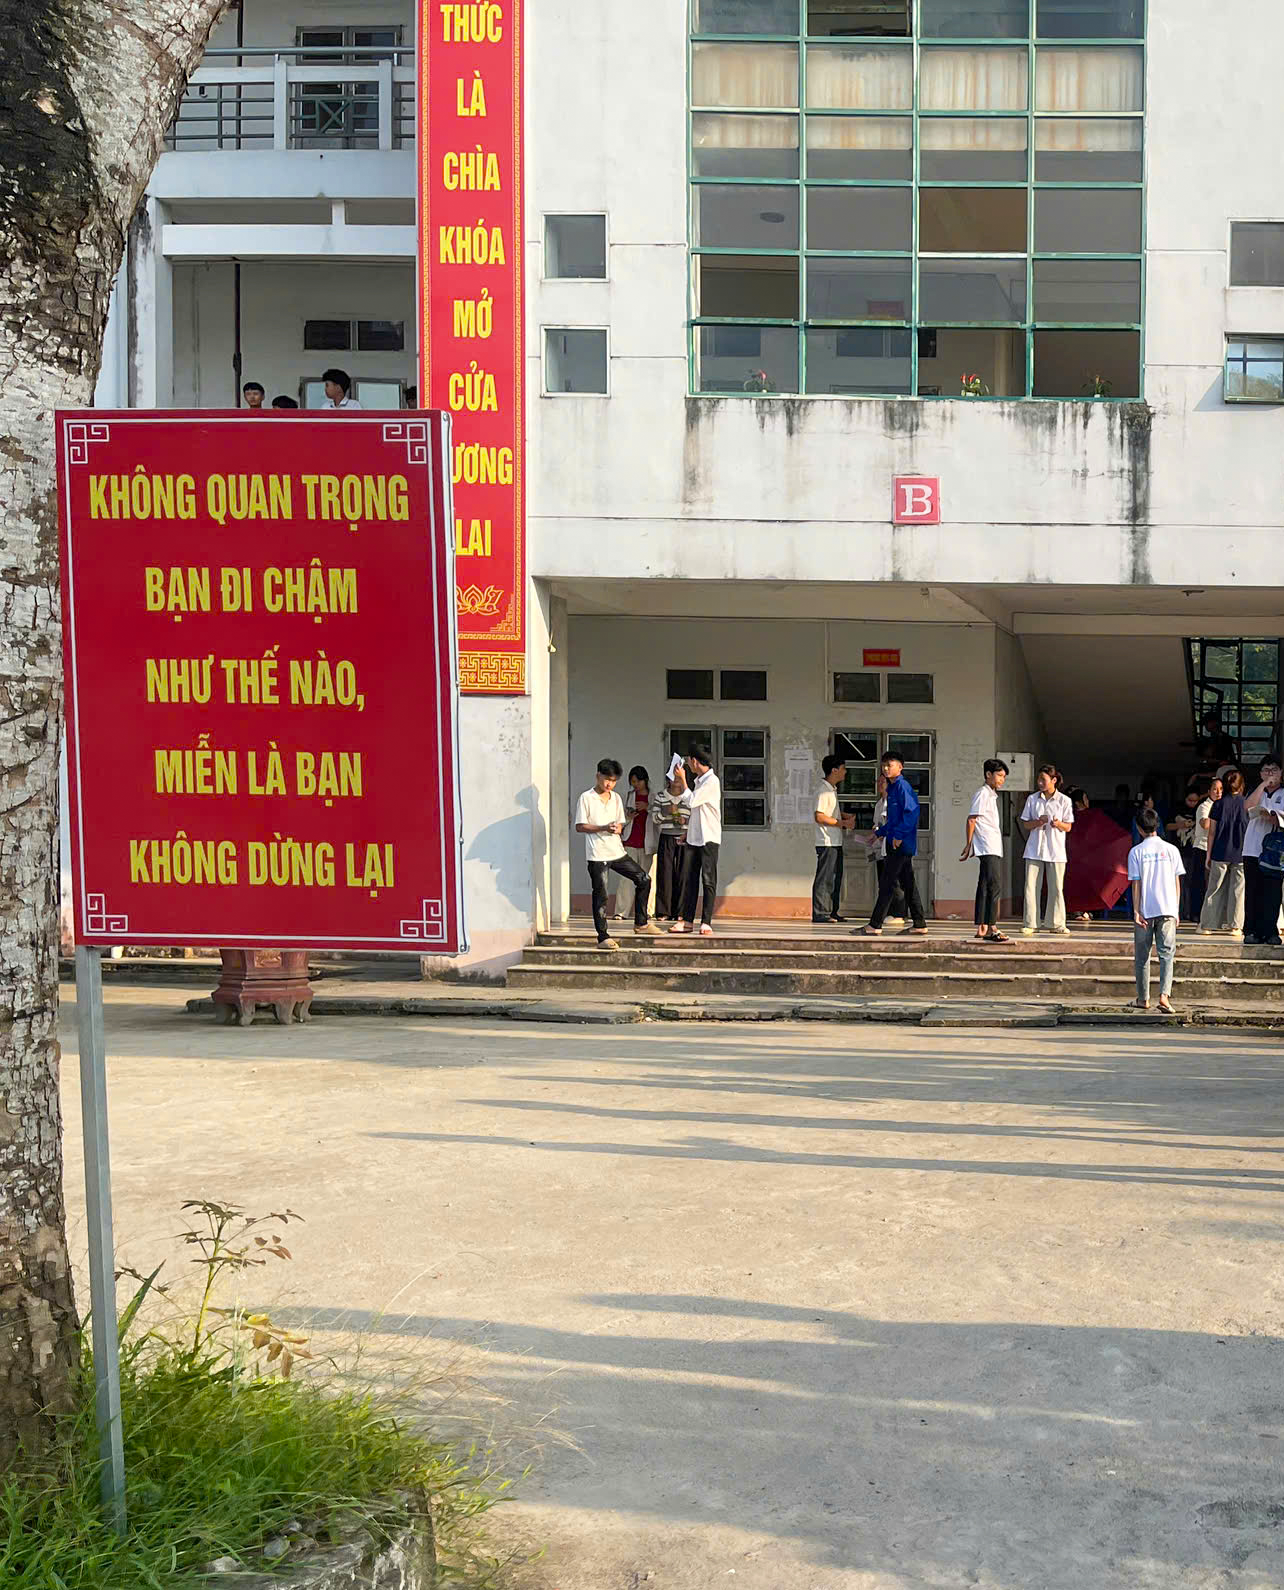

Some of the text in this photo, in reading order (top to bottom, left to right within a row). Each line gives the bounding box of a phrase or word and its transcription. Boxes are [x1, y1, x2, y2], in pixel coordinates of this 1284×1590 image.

[440, 0, 502, 43] THỨC
[457, 71, 486, 116] LÀ
[443, 144, 501, 191] CHÌA
[440, 219, 505, 264] KHÓA
[454, 288, 493, 338] MỞ
[449, 361, 498, 411] CỬA
[452, 442, 513, 485] ƯƠNG
[90, 465, 408, 530] KHÔNG QUAN TRỌNG
[900, 484, 932, 516] B
[456, 520, 491, 556] LAI
[146, 558, 357, 623] BẠN ĐI CHẬM
[147, 645, 364, 711] NHƯ THẾ NÀO,
[155, 733, 362, 806] MIỄN LÀ BẠN
[130, 831, 394, 897] KHÔNG DỪNG LẠI
